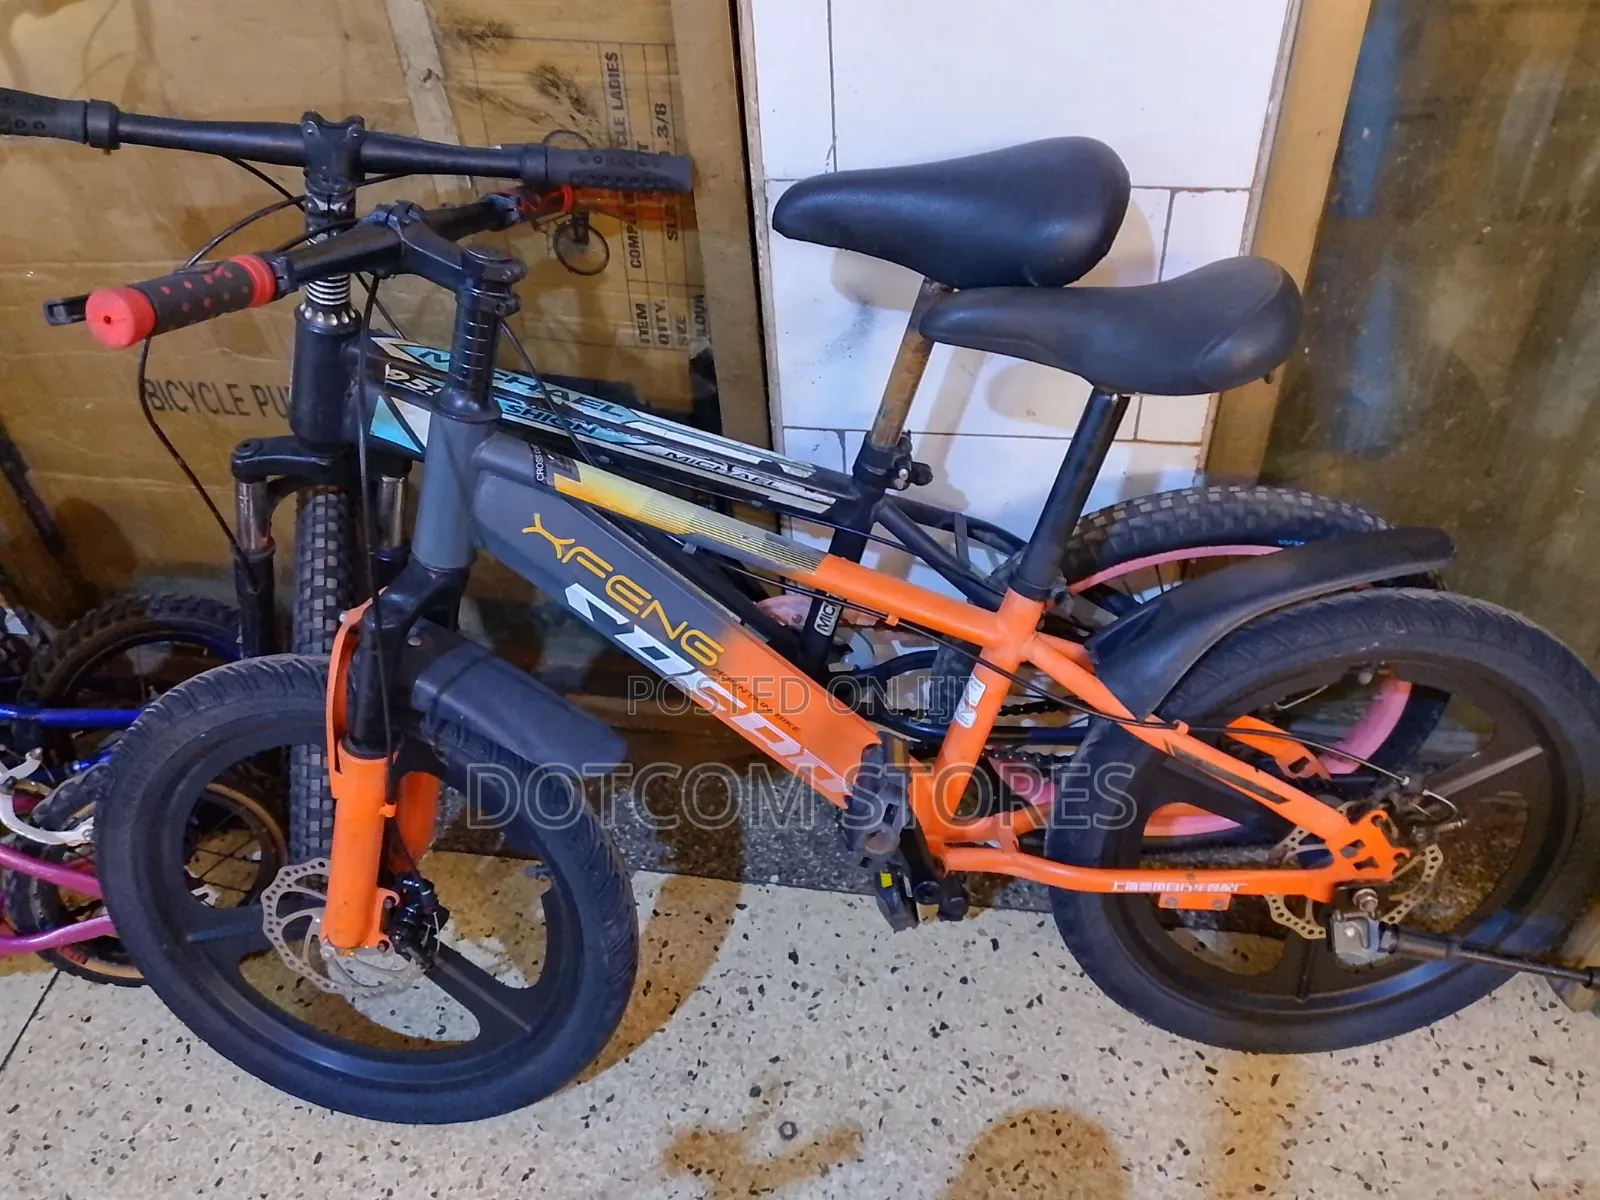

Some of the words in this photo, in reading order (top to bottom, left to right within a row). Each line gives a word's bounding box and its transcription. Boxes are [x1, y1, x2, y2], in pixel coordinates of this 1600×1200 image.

[605, 51, 625, 110] LADIES
[635, 303, 650, 344] ITEM
[143, 378, 251, 416] BICYCLE
[250, 384, 291, 418] PU
[534, 454, 545, 481] CROSS
[816, 603, 837, 632] MIC
[774, 713, 801, 733] BIKE
